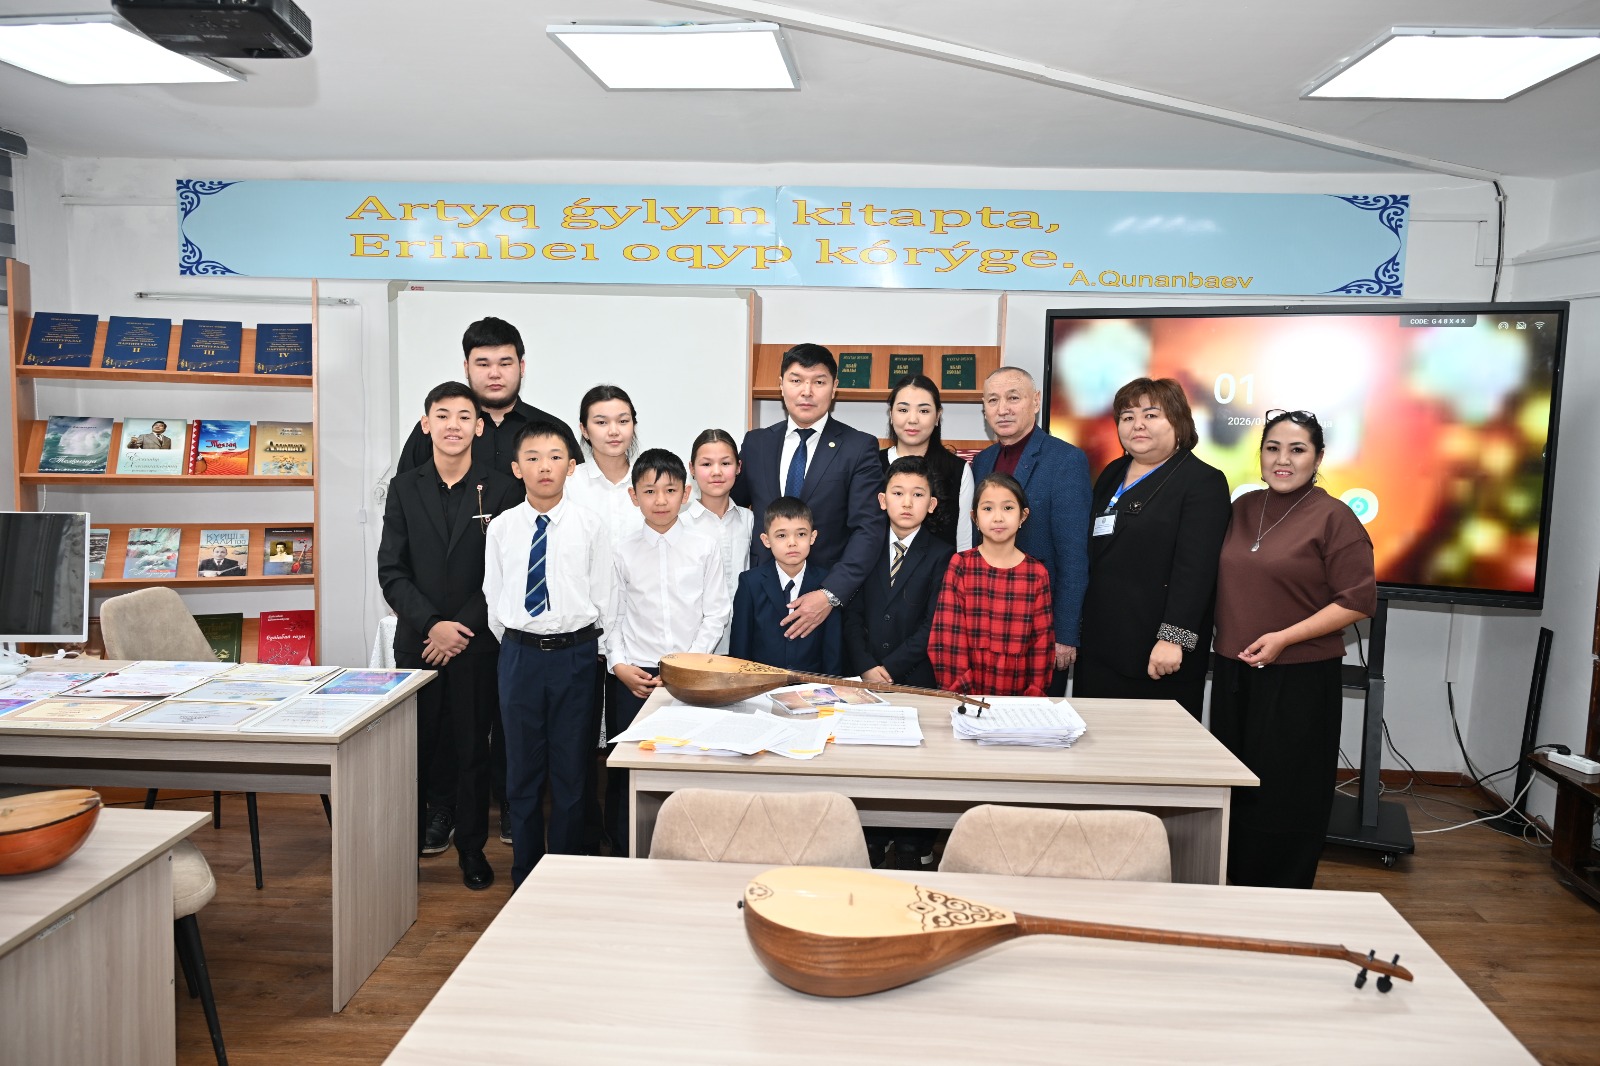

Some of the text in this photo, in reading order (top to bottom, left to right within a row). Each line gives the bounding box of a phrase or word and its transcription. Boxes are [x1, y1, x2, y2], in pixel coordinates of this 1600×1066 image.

[346, 195, 540, 230] Artyq
[792, 200, 1060, 235] kitapta,
[622, 243, 793, 271] oqyp
[816, 238, 1075, 275] kórýge.
[1228, 416, 1266, 427] 2026/01
